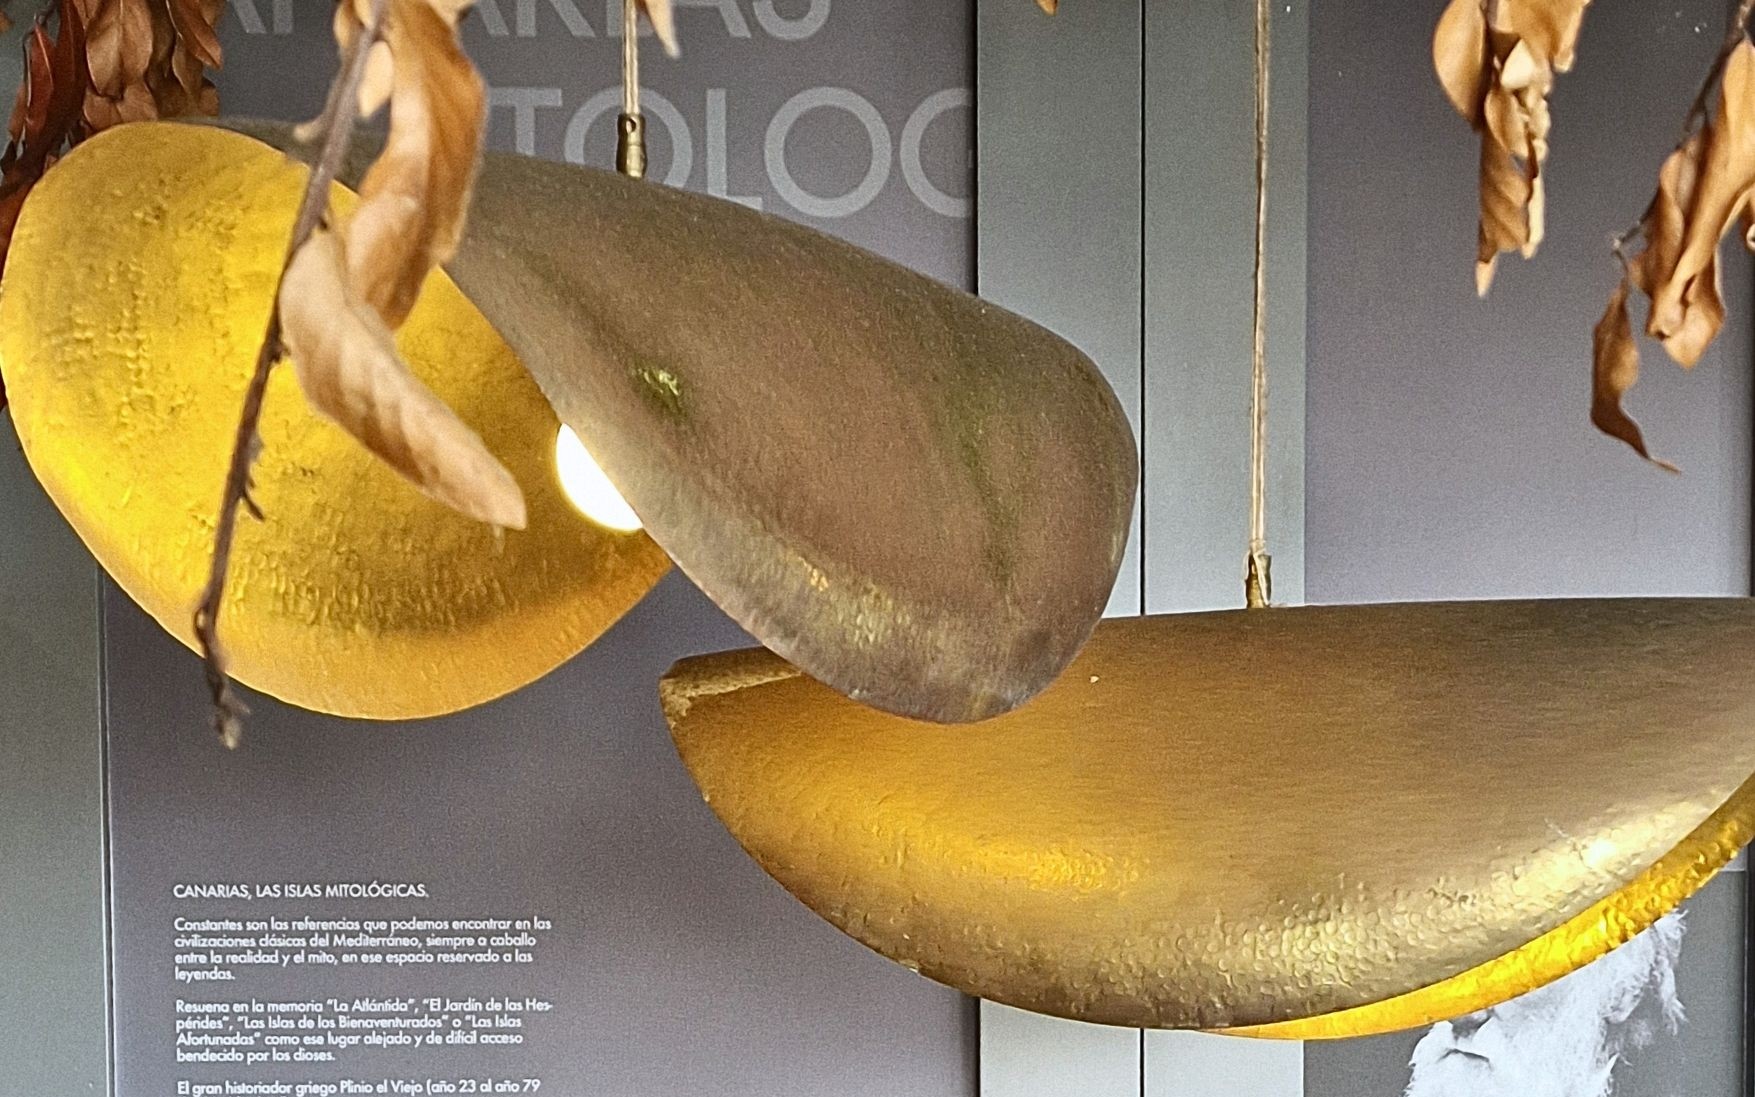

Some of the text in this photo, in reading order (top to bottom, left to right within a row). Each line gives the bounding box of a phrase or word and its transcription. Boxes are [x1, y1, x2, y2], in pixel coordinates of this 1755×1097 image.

[173, 884, 428, 900] CANARIAS, LAS ISLAS MITOLÓGICAS.
[173, 917, 551, 935] Constantes son las referencias que podemos encontrar en las
[174, 933, 536, 951] civilizaciones clásicas del Mediterráneo, siempre a caballo
[174, 967, 235, 984] leyendas.
[176, 1048, 335, 1066] bendecido por los dioses.
[177, 1081, 189, 1095] El
[224, 1081, 292, 1095] historiador
[295, 1080, 337, 1097] griego
[340, 1080, 373, 1094] Plinio
[376, 1080, 388, 1094] el
[390, 1080, 423, 1097] Viejo
[426, 1080, 456, 1097] (año
[458, 1079, 476, 1093] 23
[479, 1079, 492, 1093] al
[494, 1079, 520, 1093] año
[522, 1079, 540, 1093] 79
